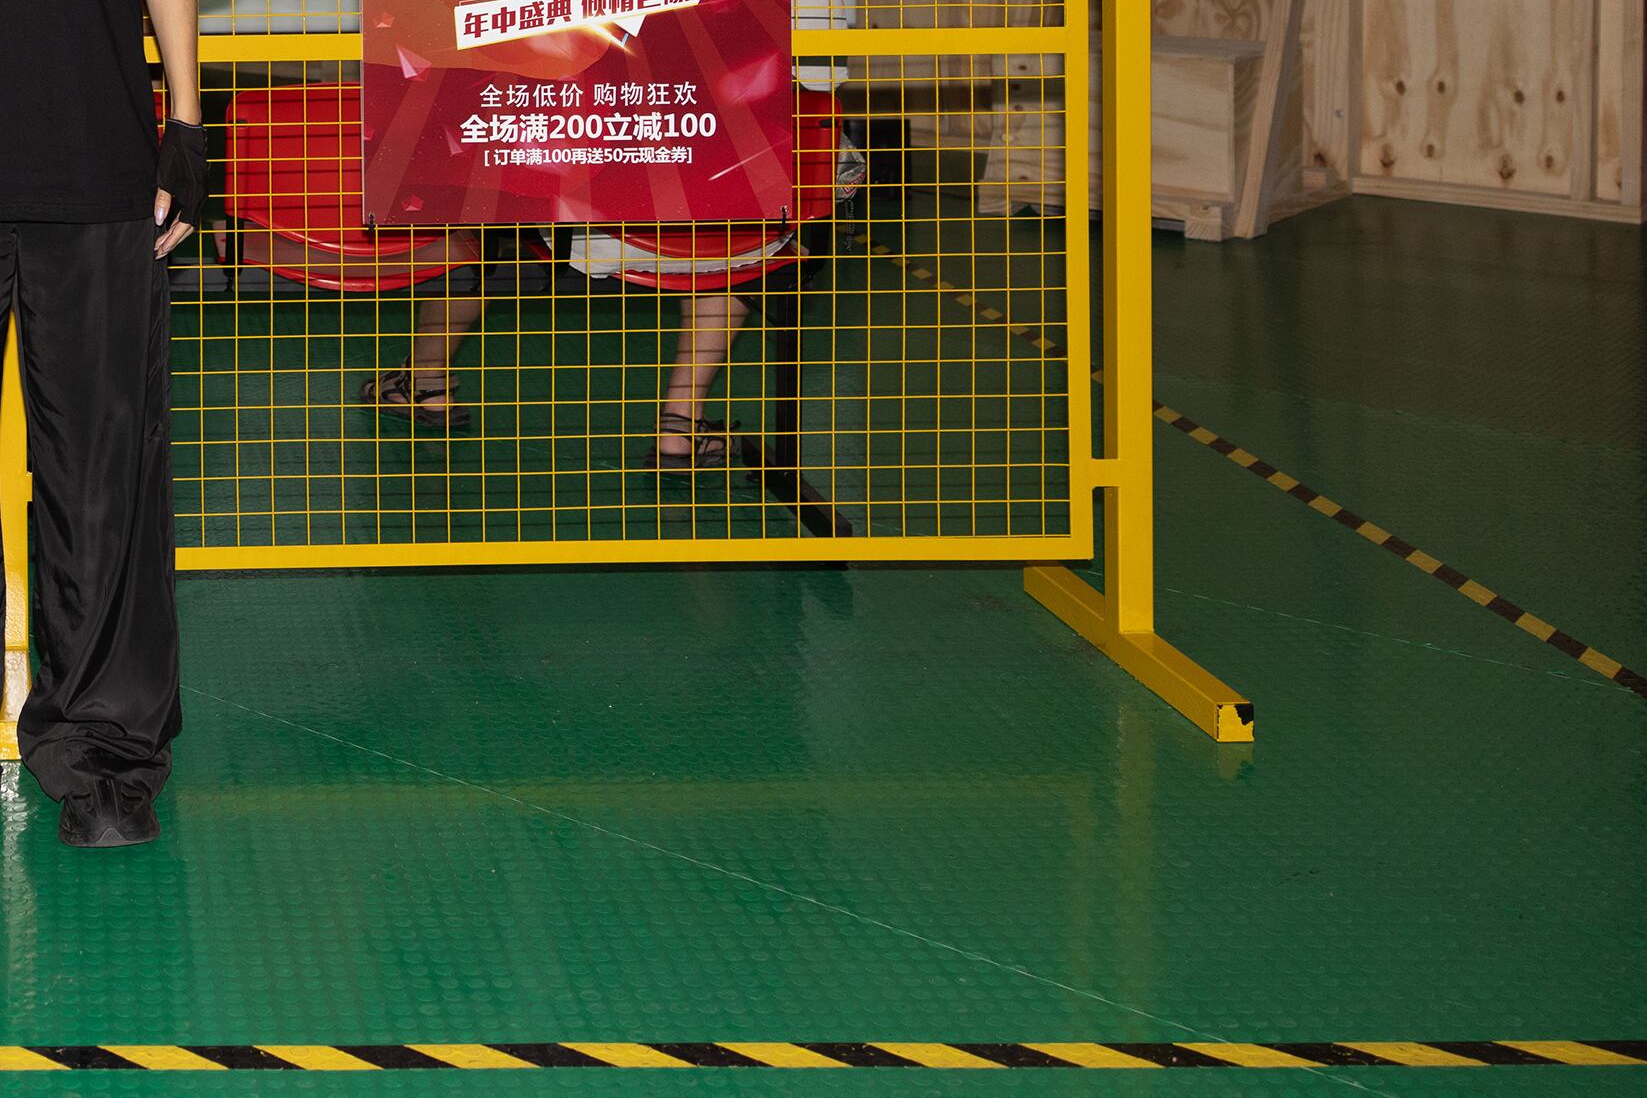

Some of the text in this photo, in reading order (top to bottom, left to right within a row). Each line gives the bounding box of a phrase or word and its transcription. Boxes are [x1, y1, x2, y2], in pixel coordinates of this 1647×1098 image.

[479, 81, 698, 108] 全场低价 购物狂欢
[460, 112, 717, 144] 全场满200立减100
